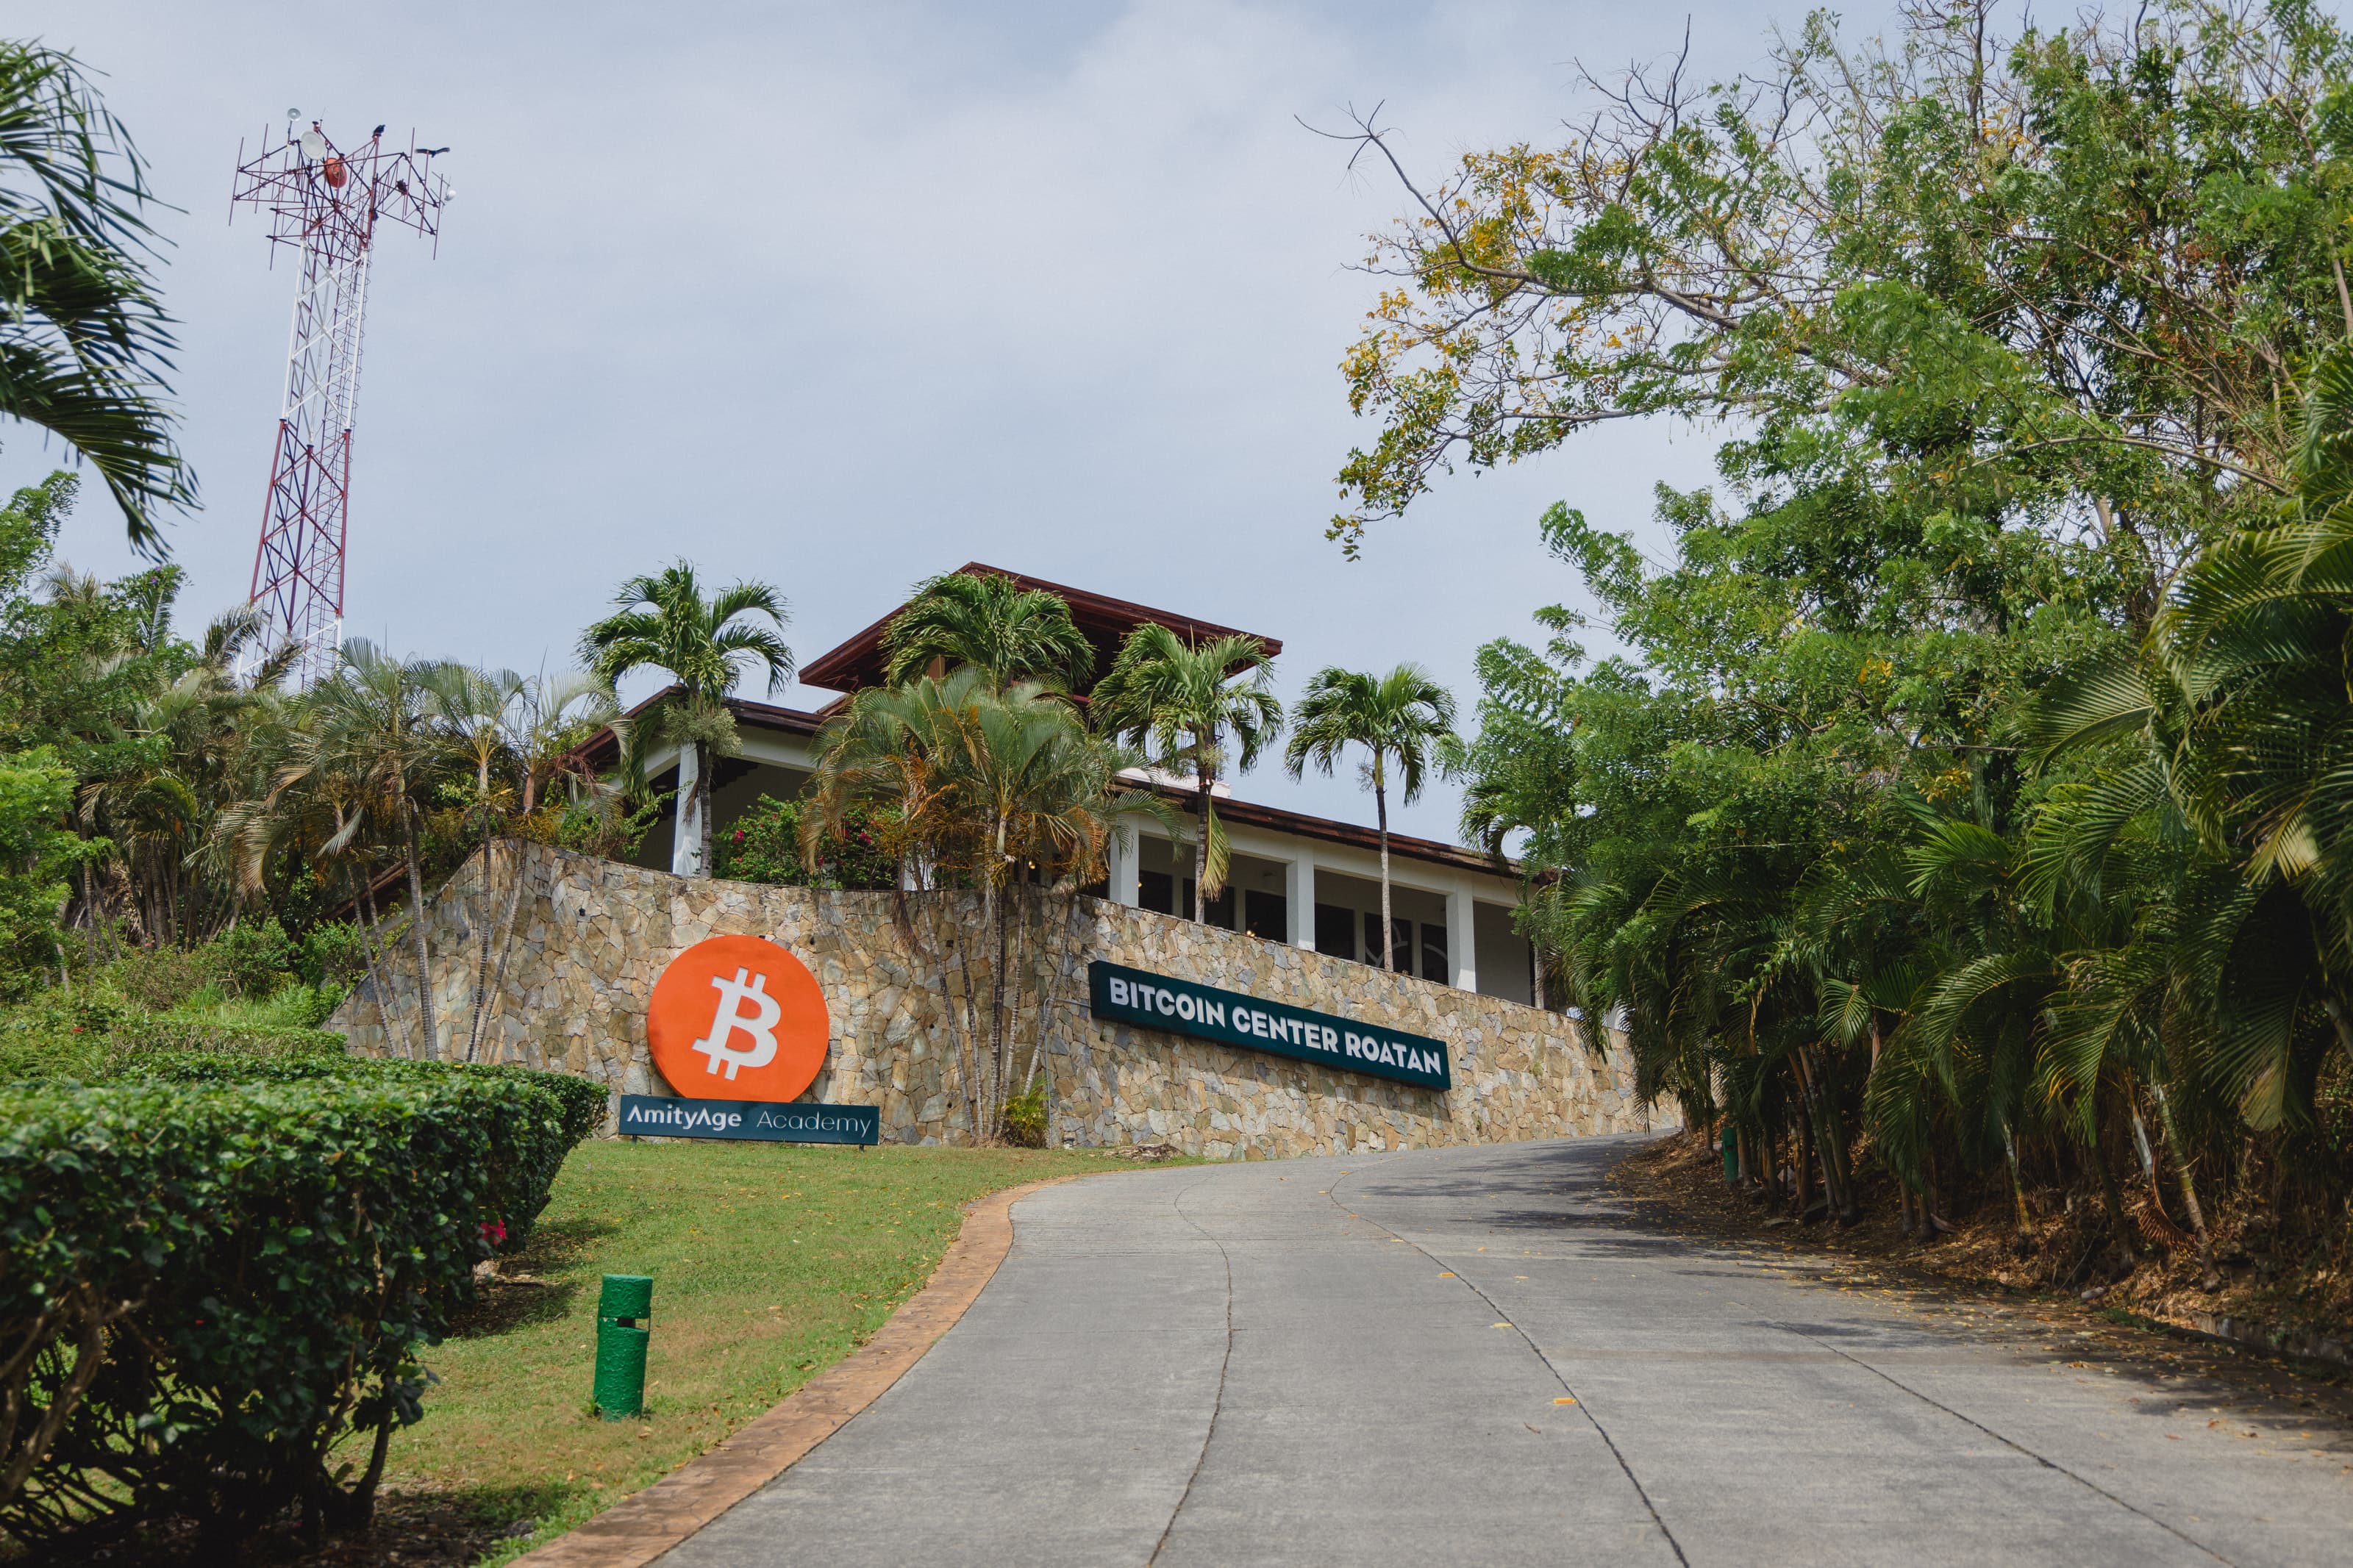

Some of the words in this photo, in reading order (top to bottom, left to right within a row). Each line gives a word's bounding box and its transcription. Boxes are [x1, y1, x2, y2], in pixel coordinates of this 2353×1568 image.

[1110, 976, 1225, 1028] BITCOIN
[1232, 1006, 1338, 1053] CENTER
[1345, 1032, 1442, 1076] ROATAN
[626, 1103, 742, 1131] AmityAge
[757, 1110, 871, 1138] Academy
